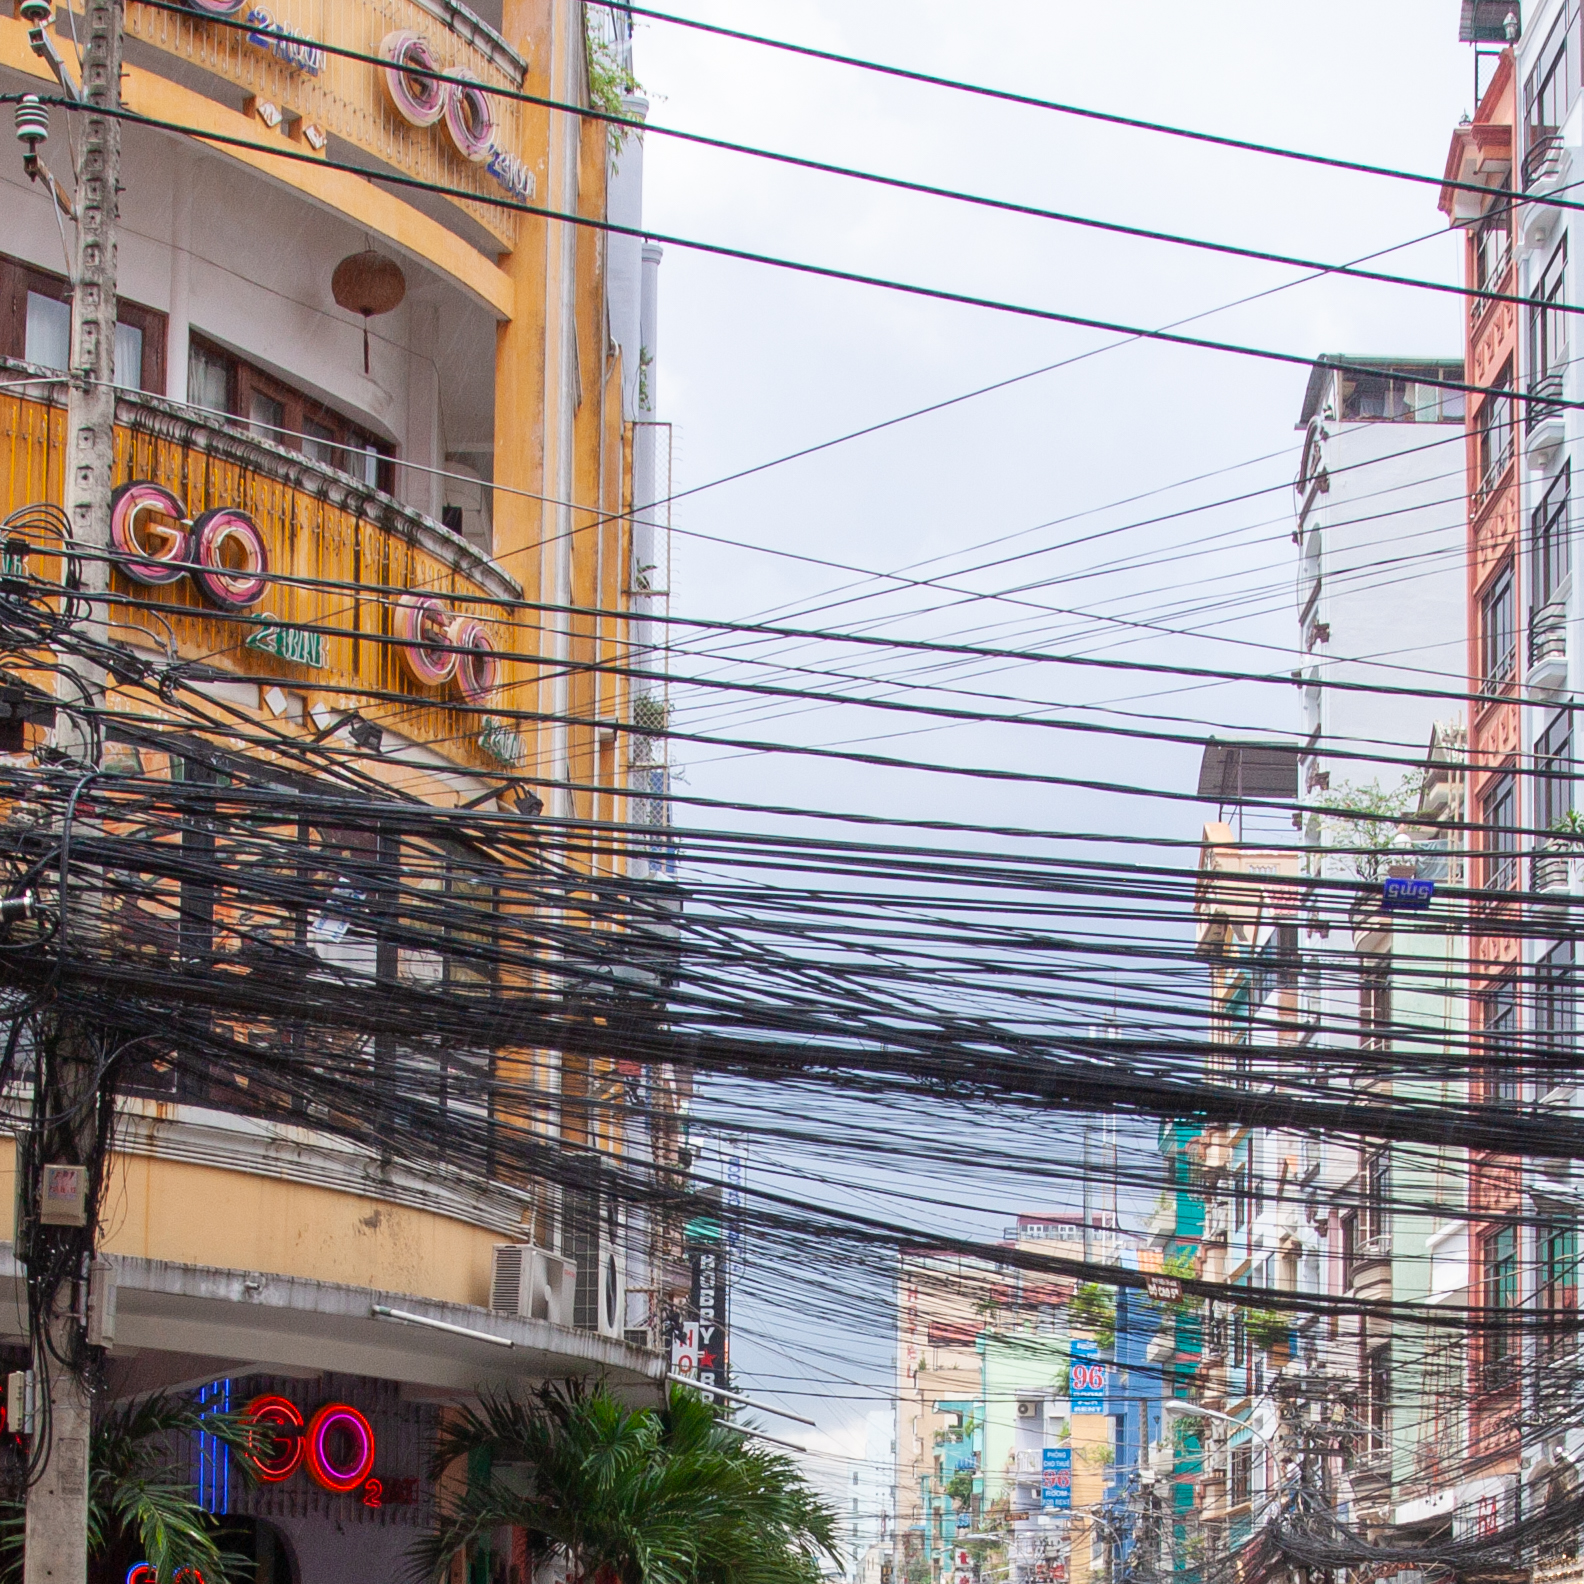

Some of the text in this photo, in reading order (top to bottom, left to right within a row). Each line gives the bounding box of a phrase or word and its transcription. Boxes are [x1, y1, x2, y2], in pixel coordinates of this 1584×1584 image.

[378, 30, 499, 162] GO
[110, 478, 271, 611] GO
[393, 594, 501, 707] GO
[1072, 1365, 1105, 1391] 96
[245, 1393, 376, 1492] GO
[1043, 1470, 1071, 1488] 96
